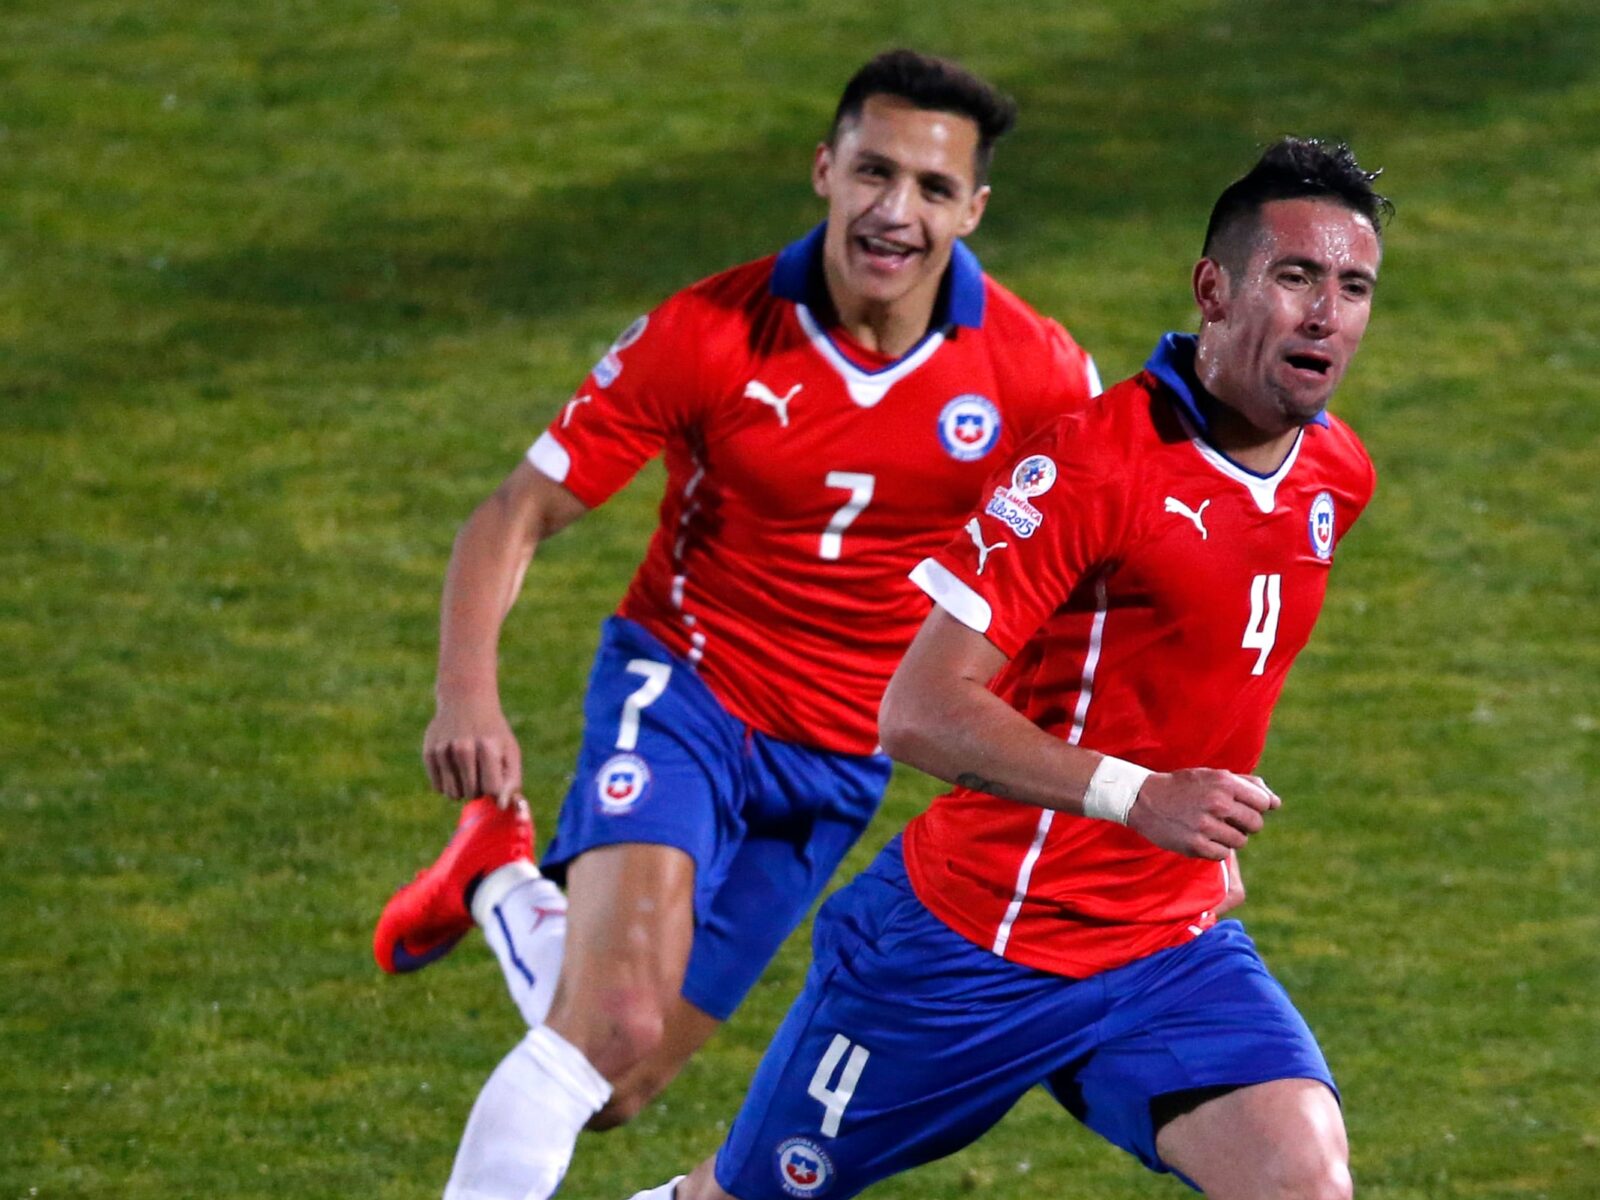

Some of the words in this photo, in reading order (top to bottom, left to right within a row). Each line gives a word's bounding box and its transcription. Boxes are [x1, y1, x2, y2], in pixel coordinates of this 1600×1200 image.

[819, 470, 876, 560] 7
[1241, 573, 1282, 676] 4
[615, 658, 673, 751] 7
[807, 1033, 871, 1138] 4
